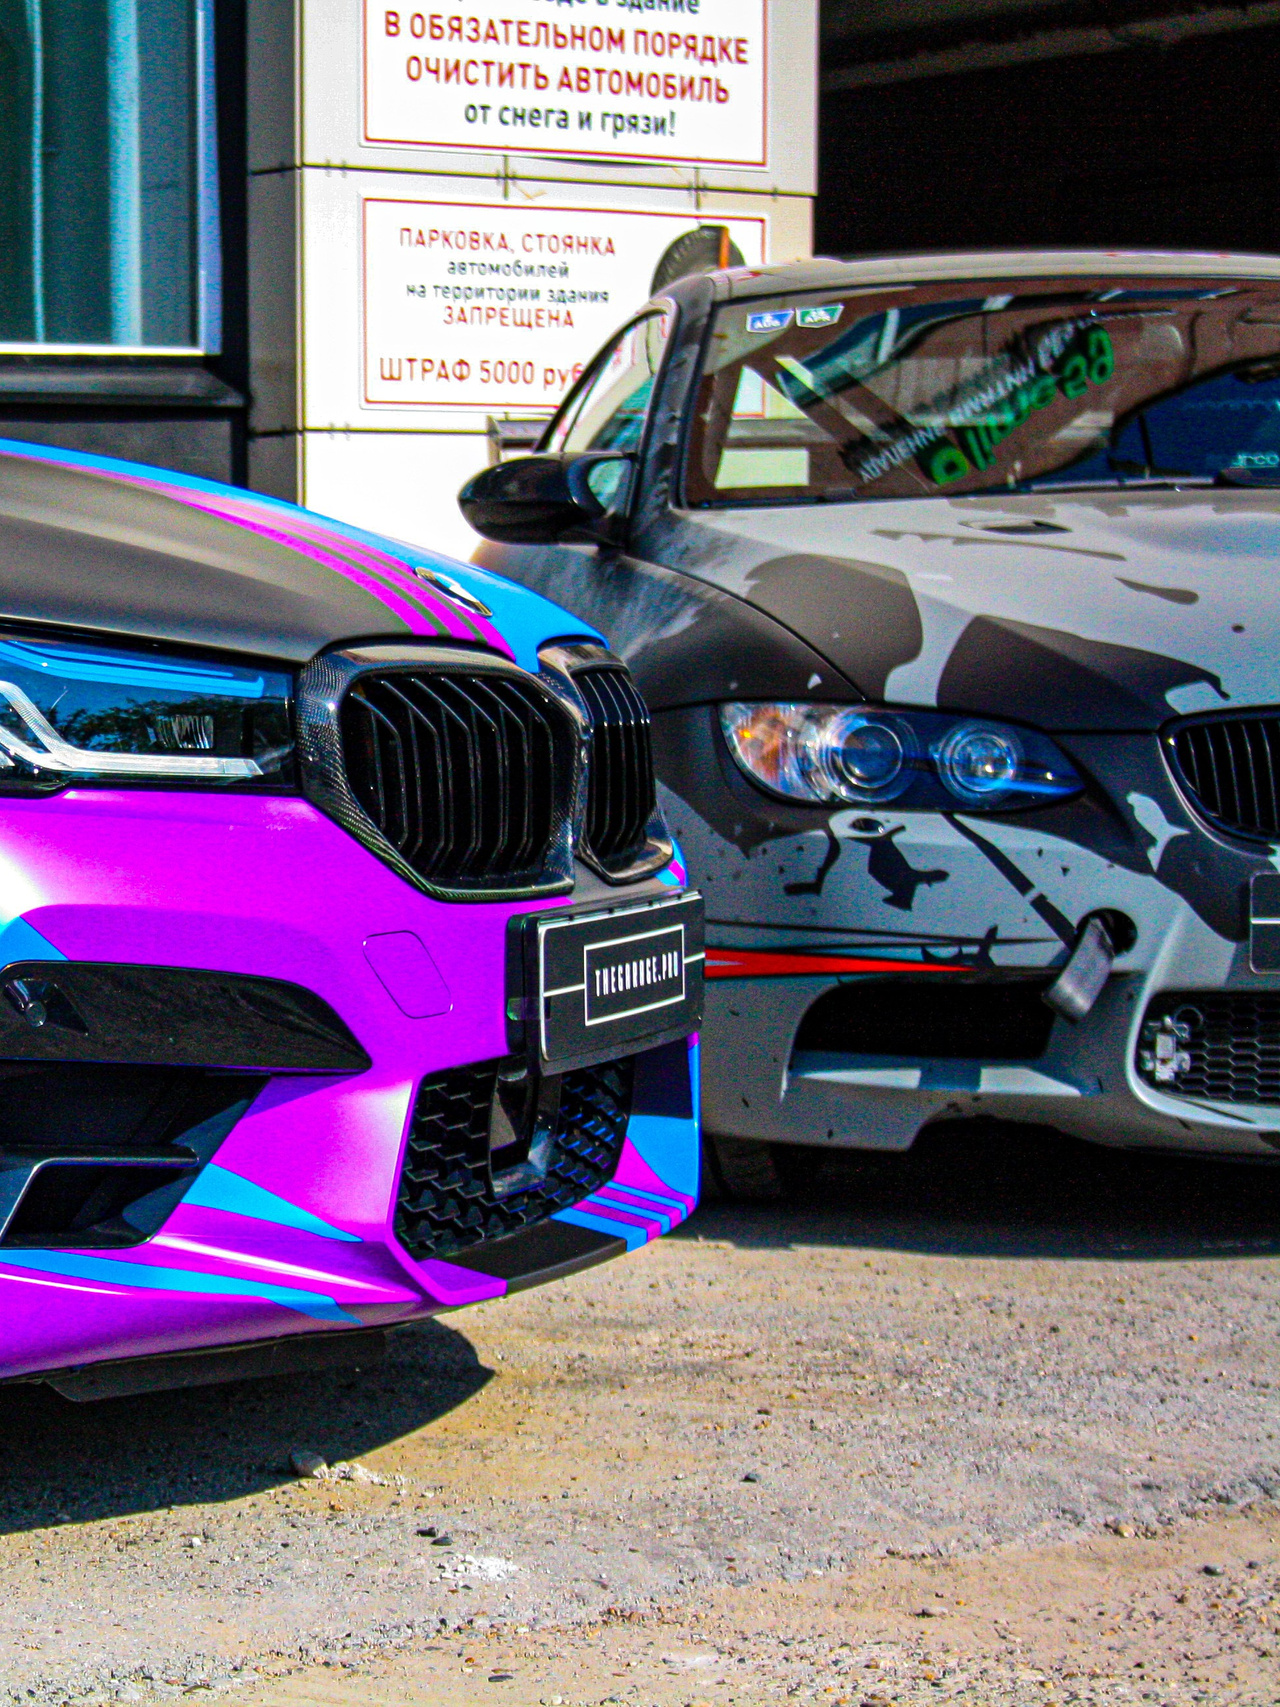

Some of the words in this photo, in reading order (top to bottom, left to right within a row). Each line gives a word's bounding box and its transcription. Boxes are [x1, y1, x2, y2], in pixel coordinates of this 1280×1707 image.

[384, 9, 401, 38] В
[410, 11, 626, 53] ОБЯЗАТЕЛЬНОМ
[633, 28, 749, 66] ПОРЯДКЕ
[406, 54, 550, 91] ОЧИСТИТЬ
[557, 65, 730, 105] АВТОМОБИЛЬ
[464, 103, 492, 125] от
[498, 104, 570, 130] снега
[578, 110, 593, 131] и
[600, 109, 676, 140] грязи!
[399, 227, 516, 255] ПАРКОВКА,
[521, 232, 617, 256] СТОЯНКА
[446, 258, 570, 279] автомобилей
[406, 283, 426, 299] на
[432, 283, 541, 303] территории
[547, 288, 610, 305] здания
[443, 305, 575, 331] ЗАПРЕЩЕНА
[379, 356, 472, 383] ШТРАФ
[479, 358, 535, 386] 5000
